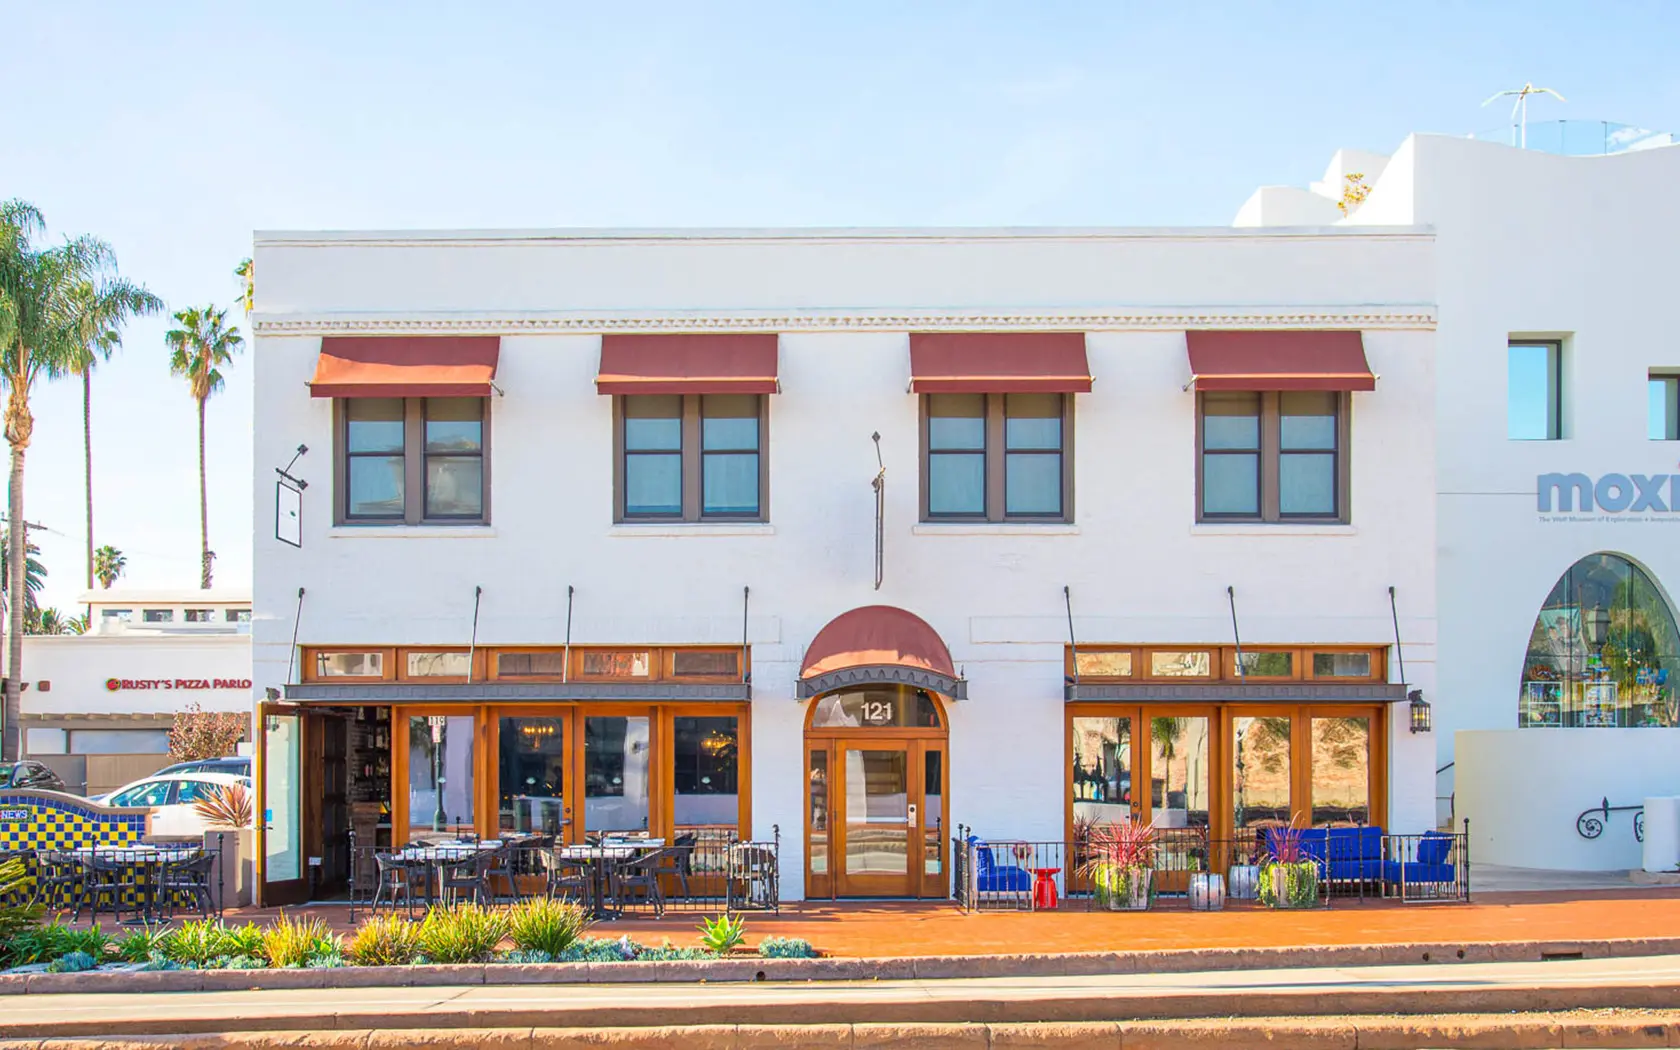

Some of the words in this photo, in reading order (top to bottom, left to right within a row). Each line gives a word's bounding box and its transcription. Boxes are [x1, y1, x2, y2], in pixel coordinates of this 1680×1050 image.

[121, 679, 173, 689] RUSTY'S
[175, 679, 211, 689] PIZZA
[213, 679, 252, 689] PARLO
[861, 701, 892, 720] 121
